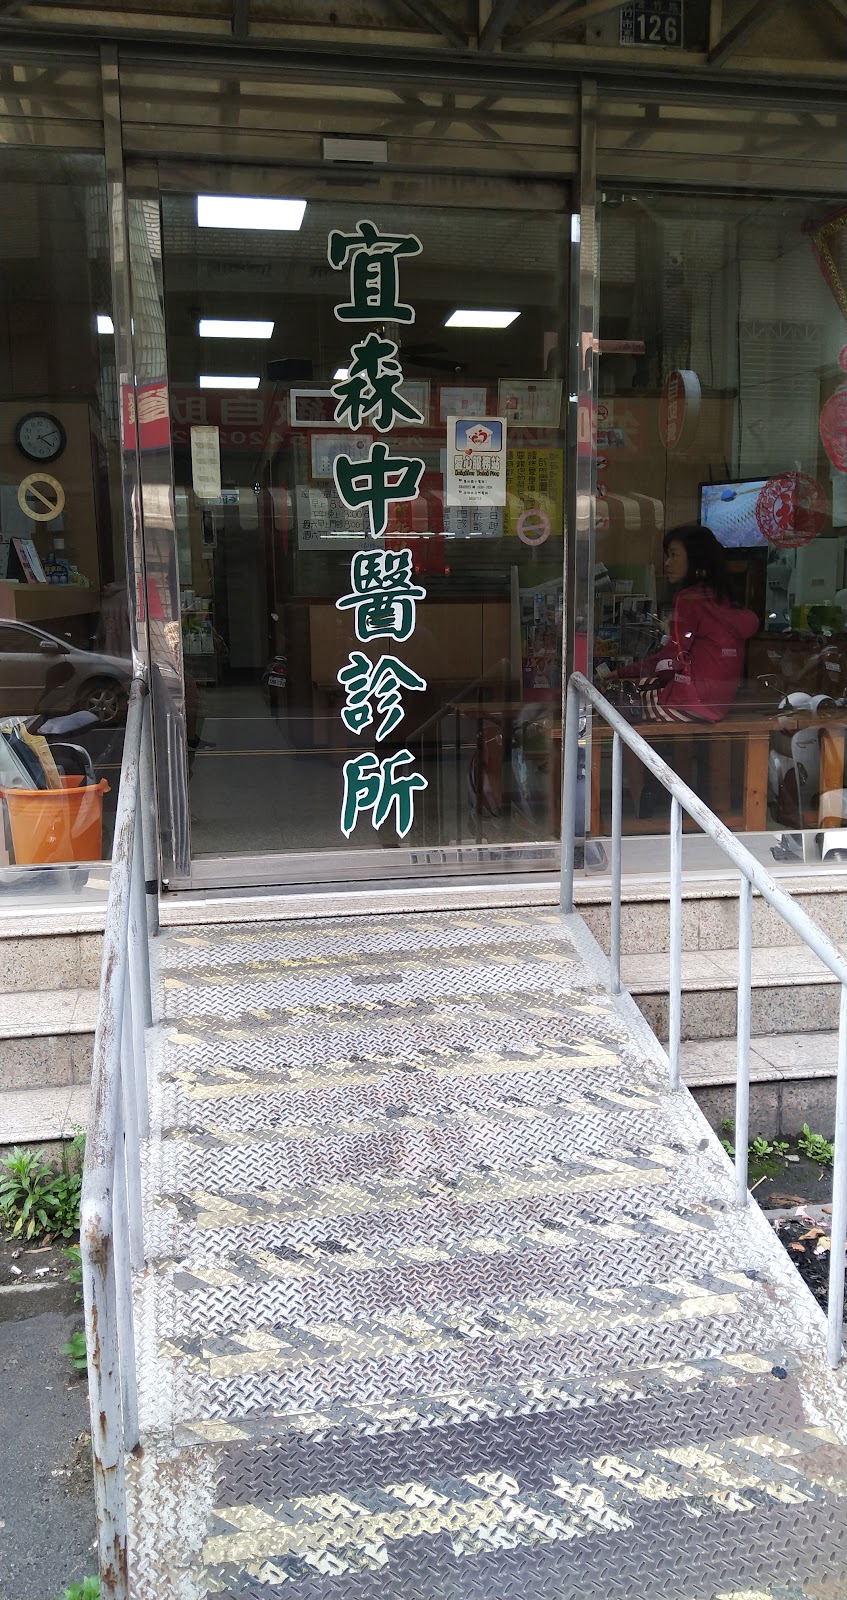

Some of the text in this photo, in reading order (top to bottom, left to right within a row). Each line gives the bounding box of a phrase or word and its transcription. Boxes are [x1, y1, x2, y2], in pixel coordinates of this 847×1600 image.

[637, 14, 677, 43] 126
[454, 455, 501, 471] 愛心服務站
[327, 219, 428, 839] 宜森中醫診所
